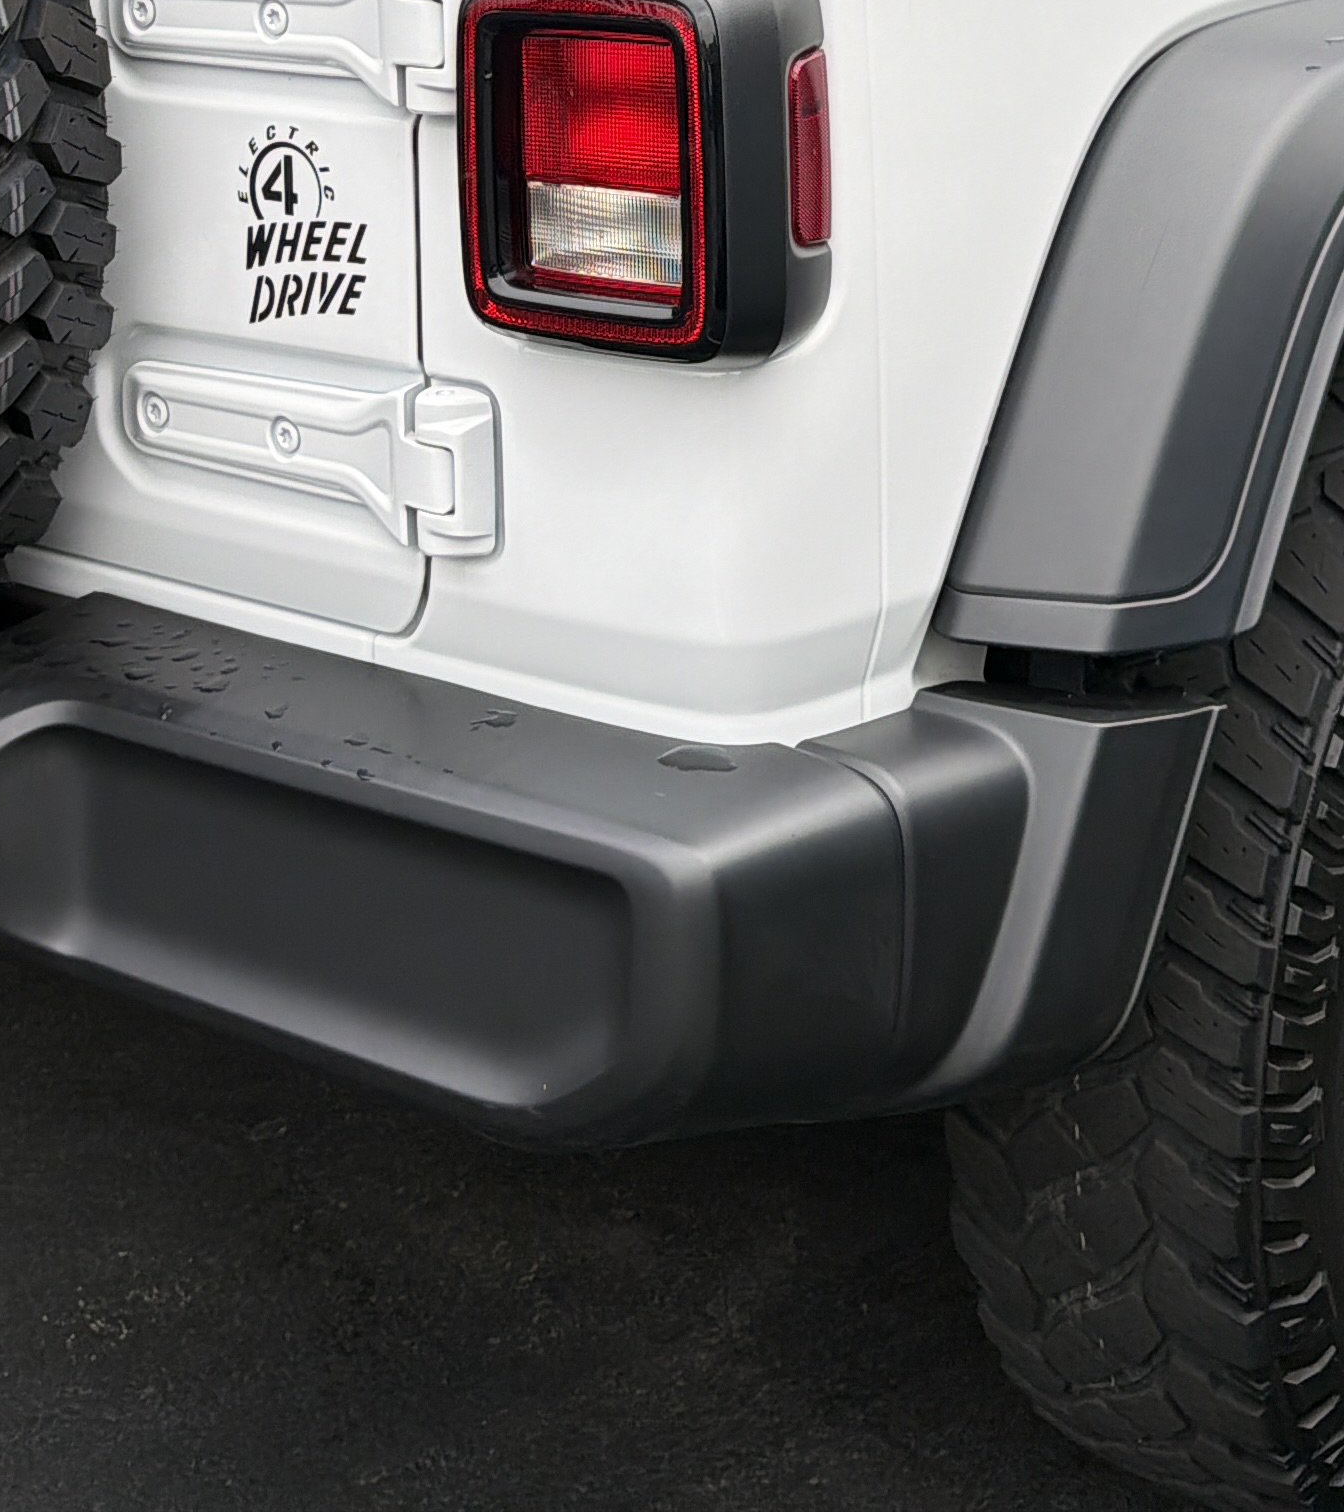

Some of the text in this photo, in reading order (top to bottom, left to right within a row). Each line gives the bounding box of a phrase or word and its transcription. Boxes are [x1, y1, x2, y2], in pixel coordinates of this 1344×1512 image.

[238, 124, 336, 205] ELECTRIC
[262, 154, 299, 216] 4
[245, 221, 368, 270] WHEEL
[249, 272, 366, 323] DRIVE
